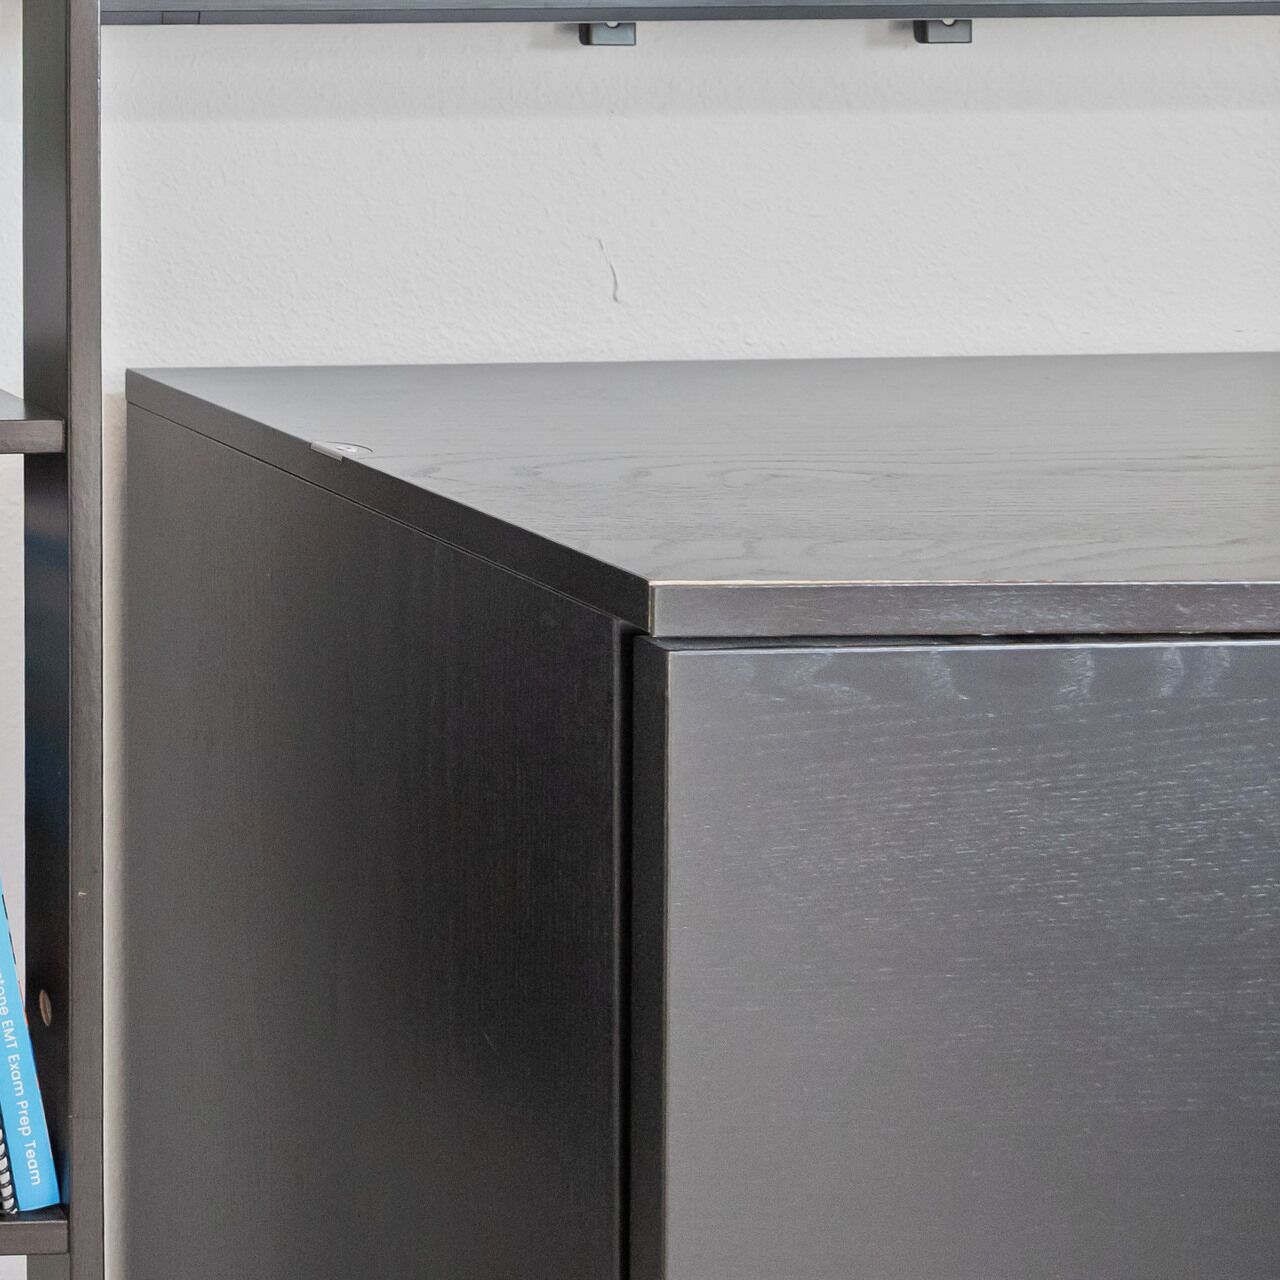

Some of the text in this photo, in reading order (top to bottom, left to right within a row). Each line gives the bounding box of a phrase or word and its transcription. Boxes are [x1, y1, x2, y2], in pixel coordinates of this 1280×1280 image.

[2, 1019, 18, 1049] EMT
[7, 1053, 24, 1097] Exam
[17, 1099, 32, 1137] Prep
[23, 1139, 41, 1186] Team
